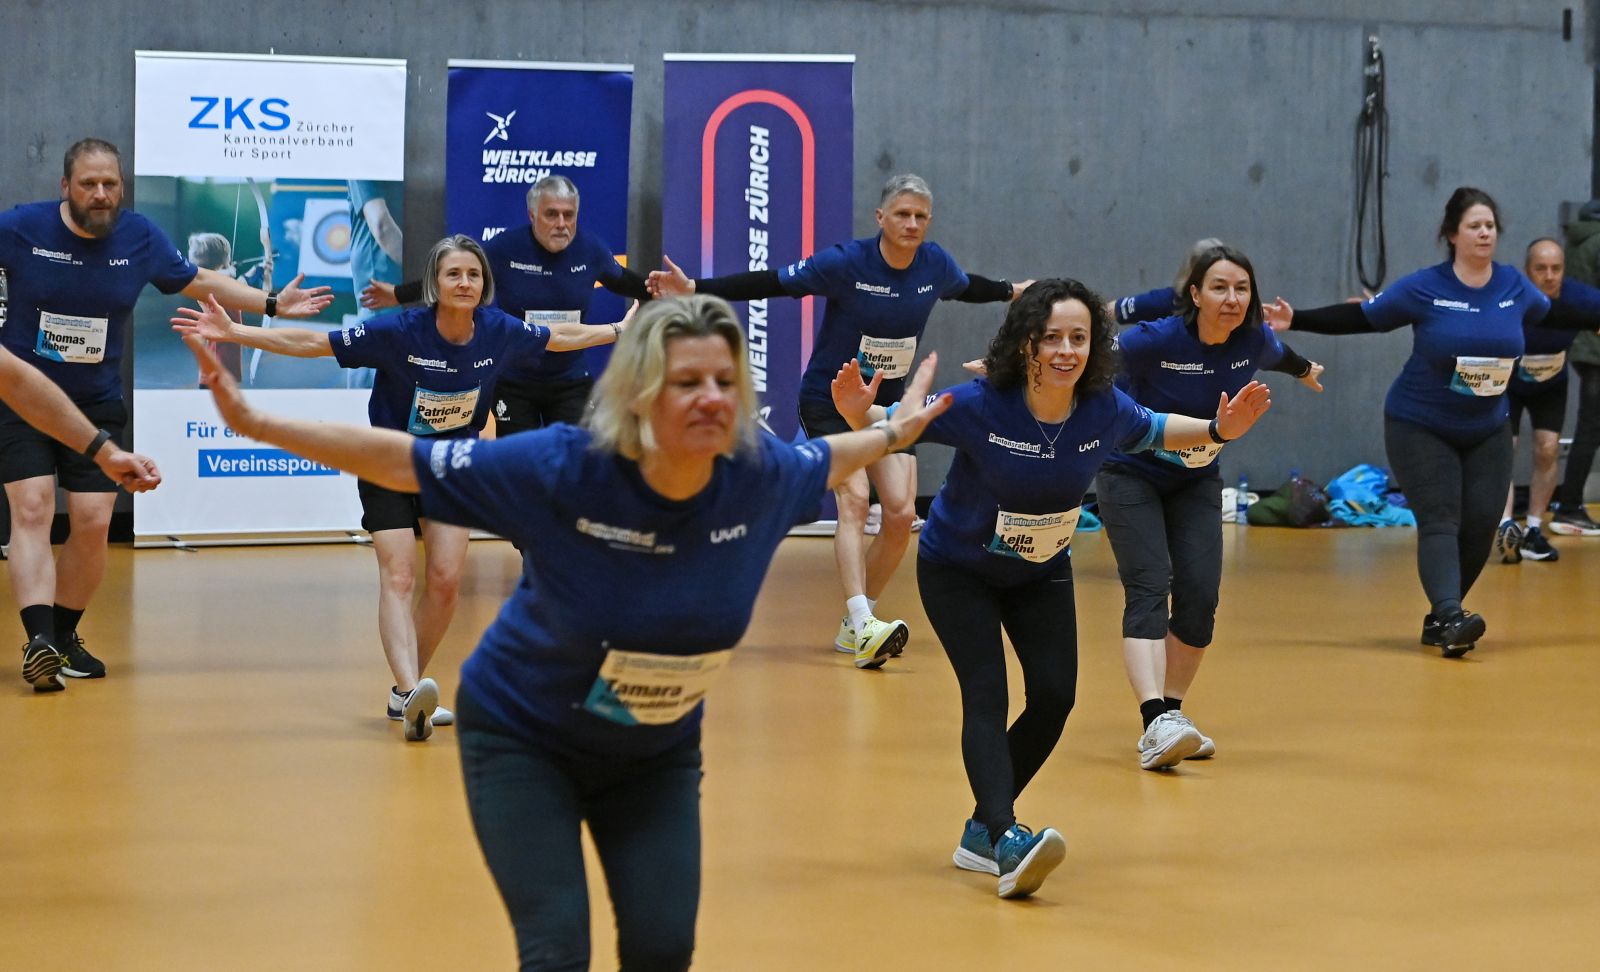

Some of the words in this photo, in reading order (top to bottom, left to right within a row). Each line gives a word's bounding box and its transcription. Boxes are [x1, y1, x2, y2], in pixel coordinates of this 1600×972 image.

[188, 96, 291, 131] ZKS
[296, 120, 355, 133] Zürcher
[224, 134, 354, 148] Kantonalverband
[224, 148, 245, 159] für
[251, 148, 292, 161] Sport
[482, 149, 597, 167] WELTKLASSE
[744, 124, 770, 224] ZÜRICH
[43, 330, 86, 345] Thomas
[85, 346, 102, 354] FDP
[862, 351, 893, 363] Stefan
[416, 404, 461, 417] Patricia
[461, 409, 473, 419] SP
[415, 414, 447, 425] Bernet
[186, 421, 218, 438] Für
[988, 433, 1041, 453] Kantonsratslauf
[1055, 536, 1069, 548] SP
[607, 678, 683, 697] Tamara
